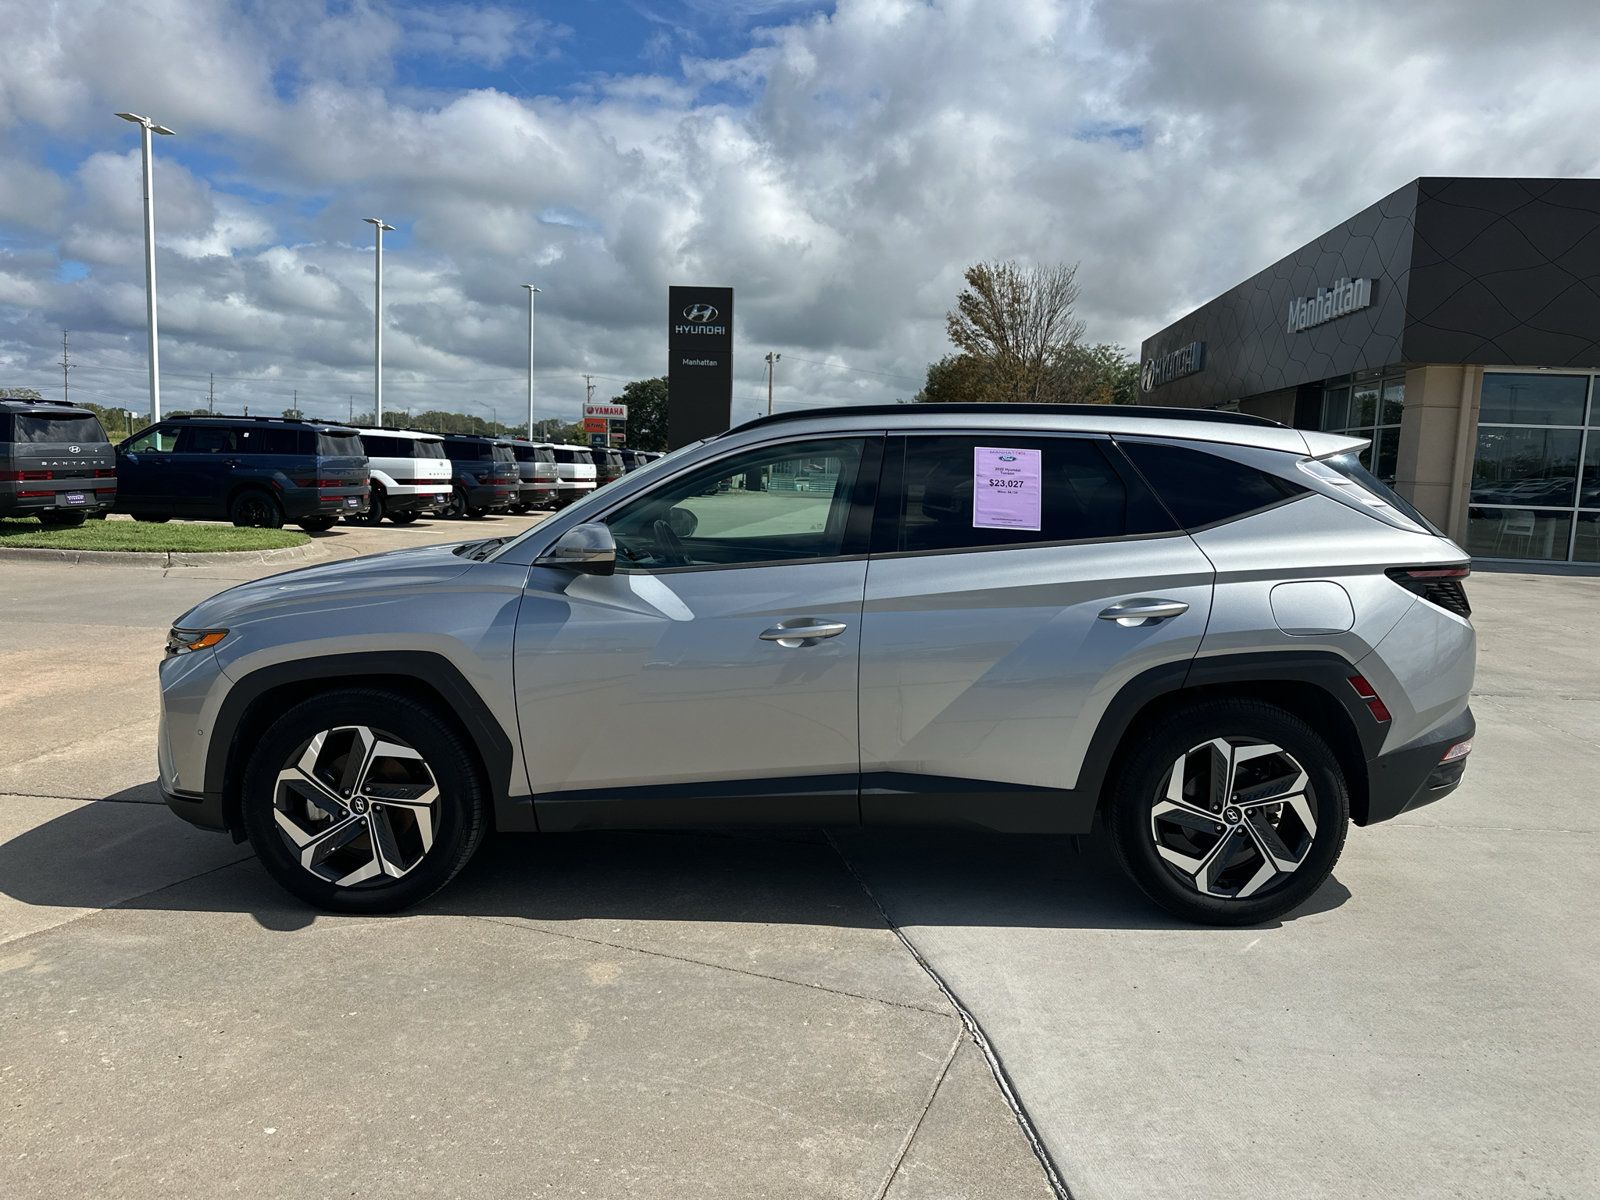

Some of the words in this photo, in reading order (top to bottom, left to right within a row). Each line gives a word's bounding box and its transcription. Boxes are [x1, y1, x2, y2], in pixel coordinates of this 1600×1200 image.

[1287, 277, 1371, 334] Manhattan
[675, 325, 725, 335] HYUNDAI
[682, 358, 718, 366] Manhattan
[594, 406, 624, 416] YAMAHA
[989, 478, 1024, 488] $23,027
